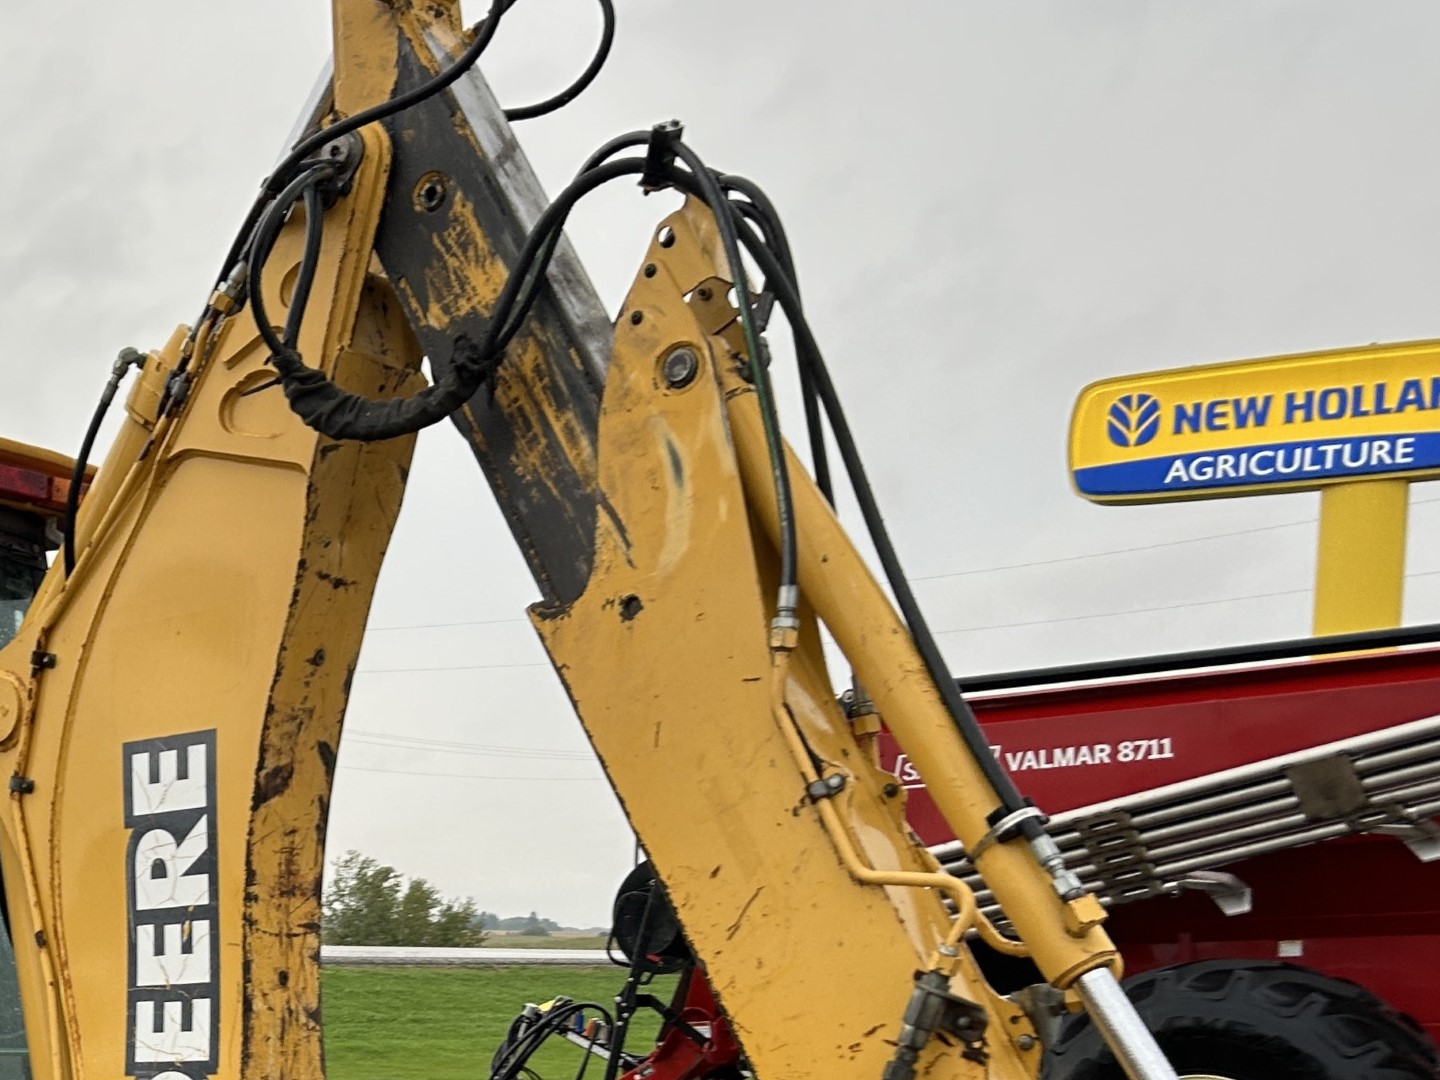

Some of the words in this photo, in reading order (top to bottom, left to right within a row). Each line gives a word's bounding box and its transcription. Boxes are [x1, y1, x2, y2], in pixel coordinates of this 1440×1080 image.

[1172, 393, 1274, 435] NEW
[1163, 437, 1416, 484] AGRICULTURE
[1006, 744, 1112, 772] VALMAR
[1116, 737, 1174, 762] 8711
